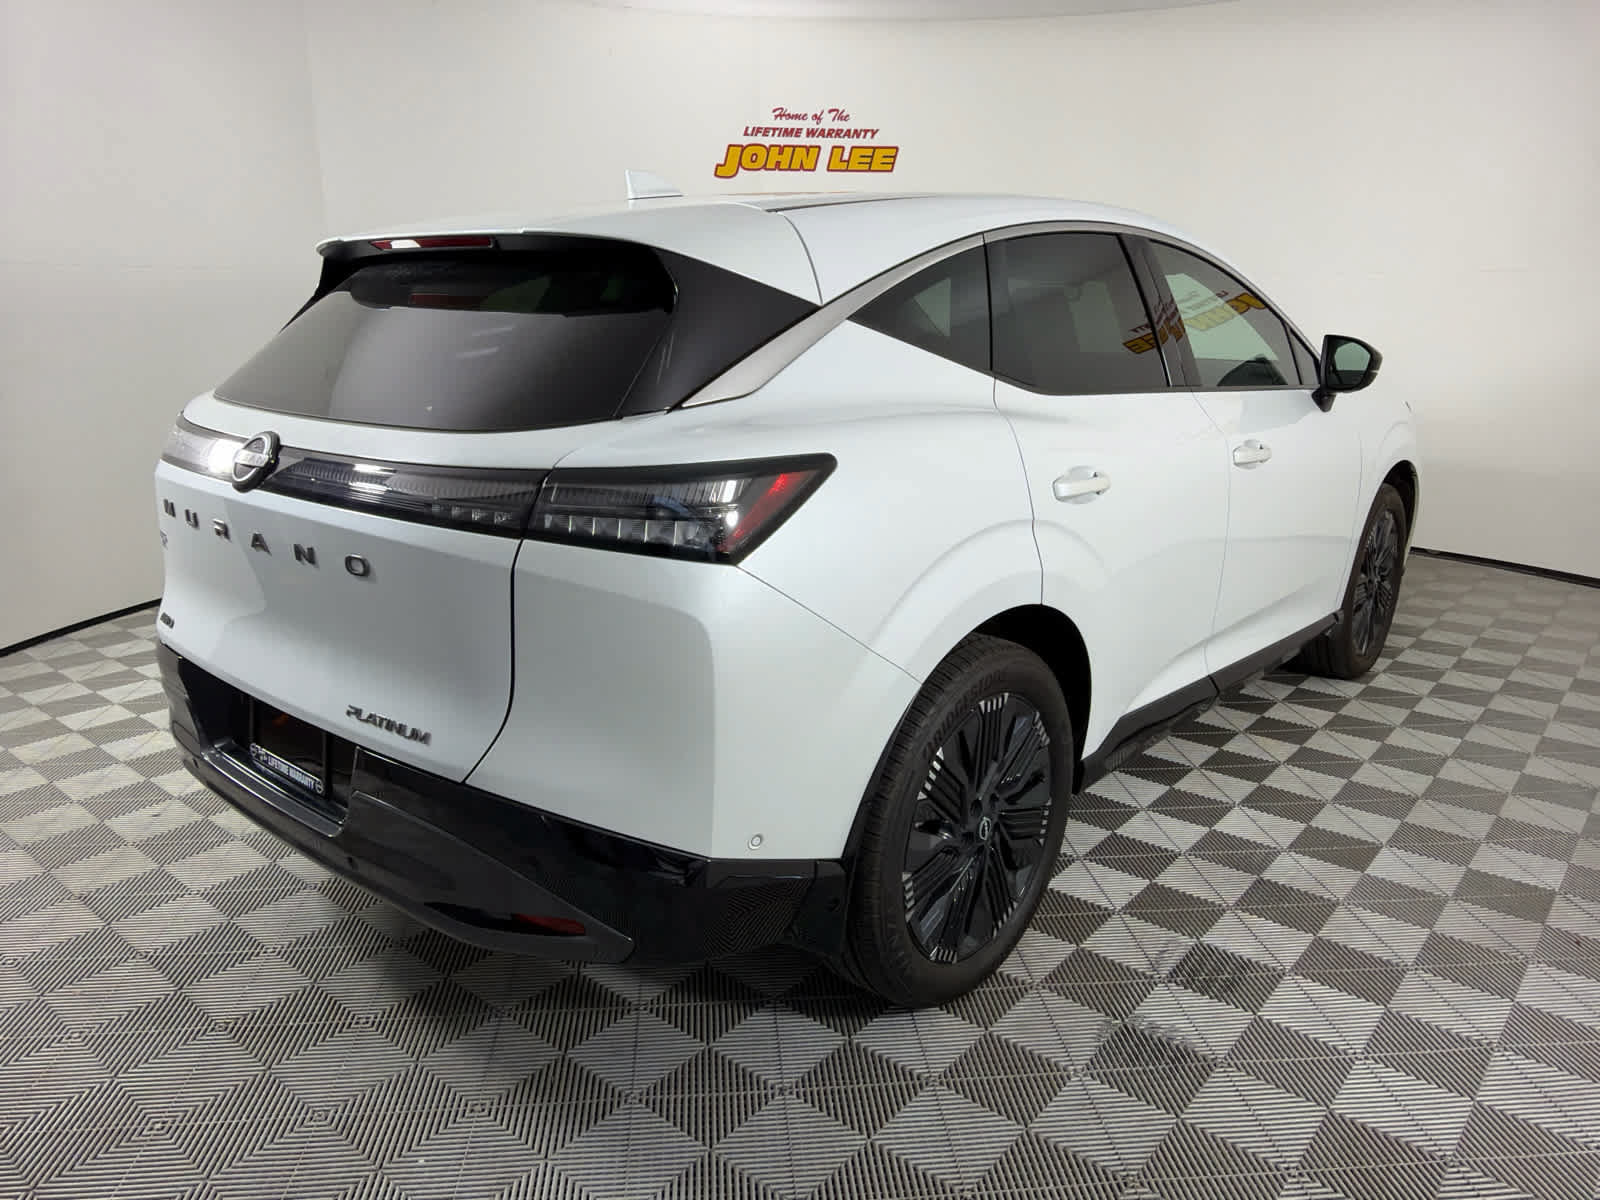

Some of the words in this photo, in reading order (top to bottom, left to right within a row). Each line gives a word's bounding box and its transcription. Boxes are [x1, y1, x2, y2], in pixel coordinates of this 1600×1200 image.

[743, 126, 803, 138] LIFETIME
[805, 127, 879, 140] WARRANTY
[772, 107, 808, 121] Home
[811, 109, 825, 125] of
[827, 108, 850, 122] The
[714, 143, 821, 179] JOHN
[826, 145, 899, 173] LEE
[164, 498, 370, 577] MURANO
[346, 704, 432, 746] PLATINUM
